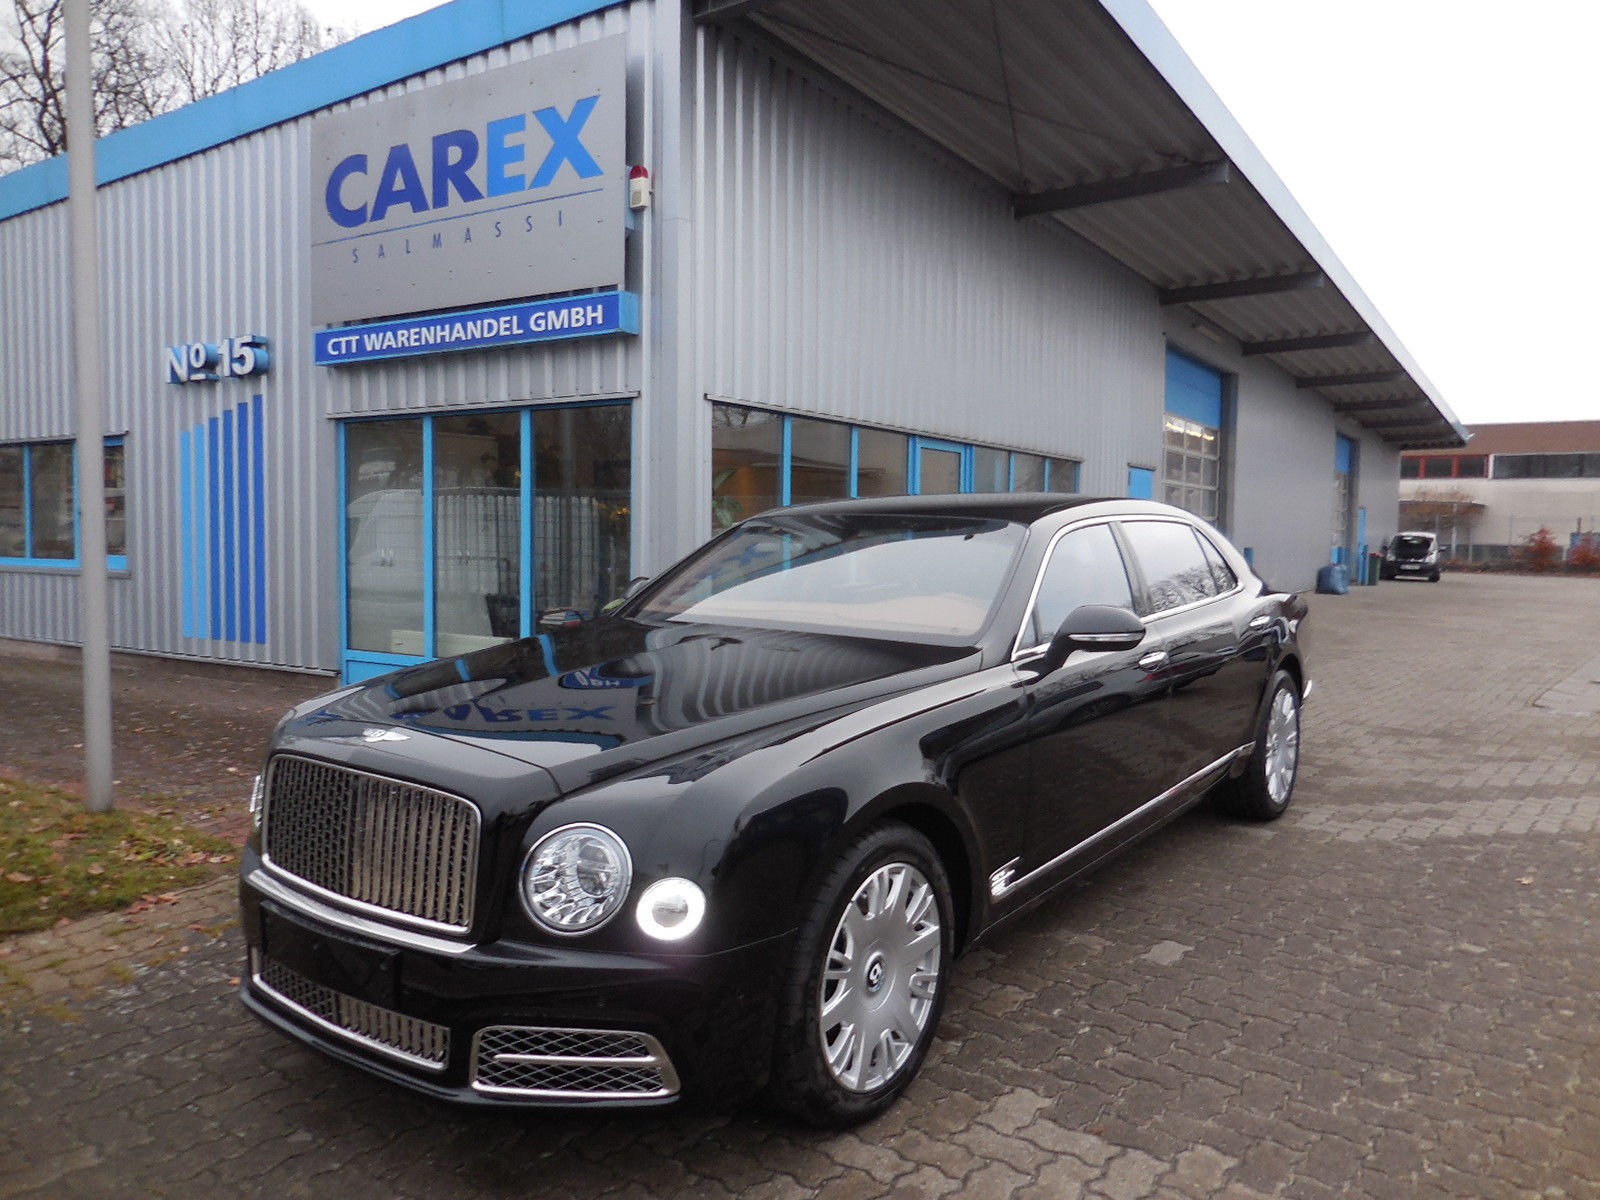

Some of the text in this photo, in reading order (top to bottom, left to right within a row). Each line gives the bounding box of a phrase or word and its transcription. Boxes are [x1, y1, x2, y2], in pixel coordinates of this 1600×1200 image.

[325, 94, 604, 229] CAREX
[352, 210, 564, 264] SALMASSI
[218, 334, 256, 378] 15
[326, 304, 603, 356] CTT WARENHANDEL GMBH
